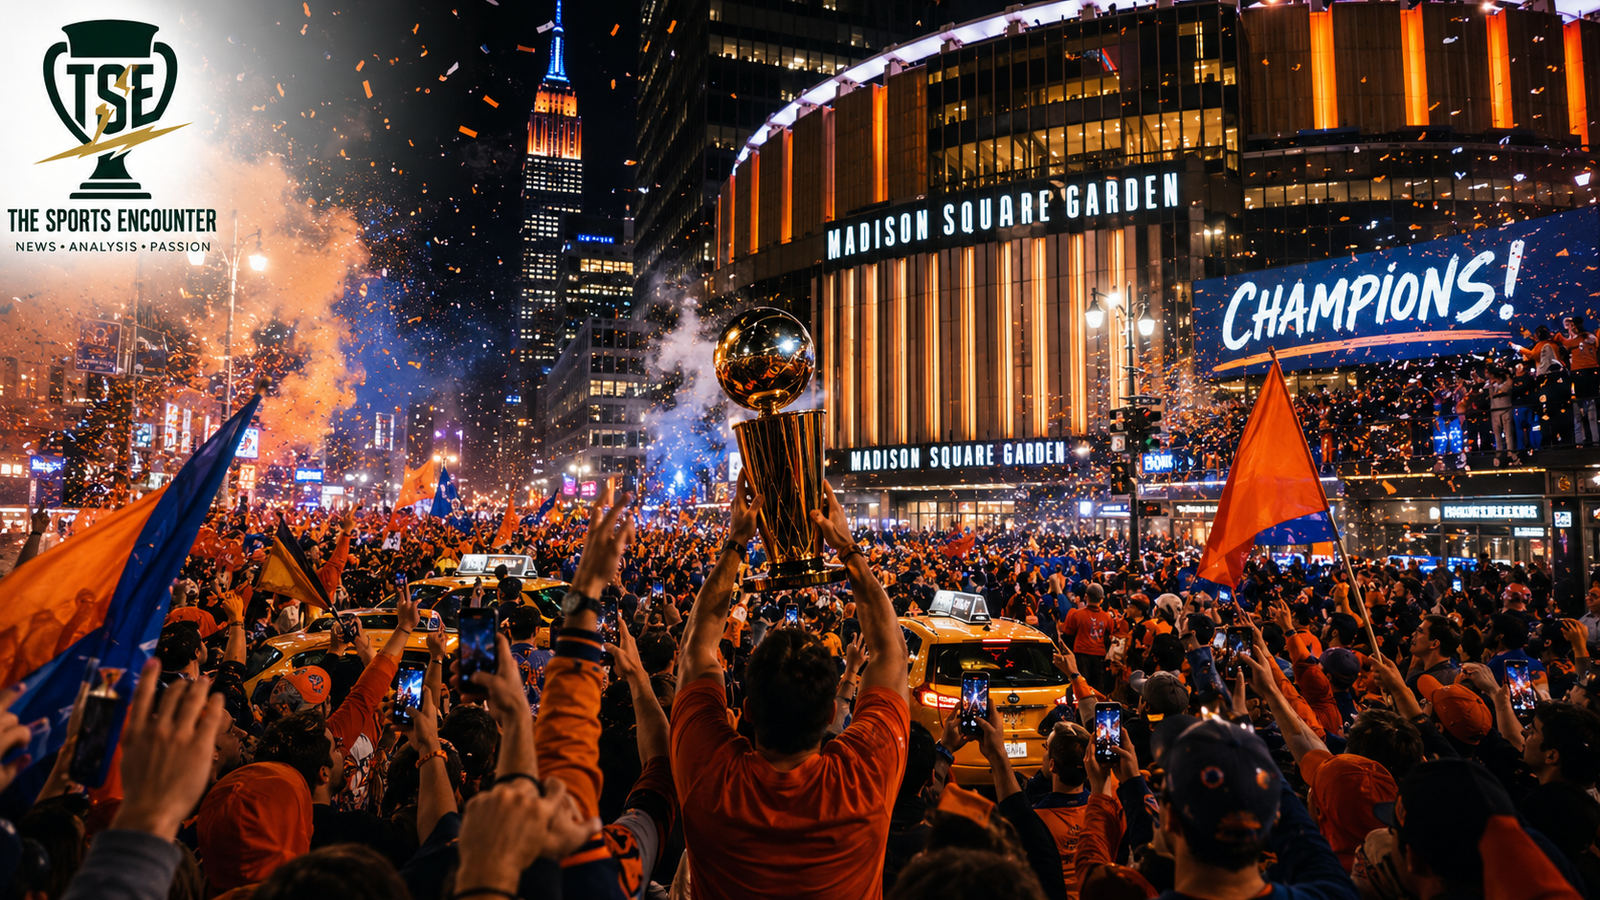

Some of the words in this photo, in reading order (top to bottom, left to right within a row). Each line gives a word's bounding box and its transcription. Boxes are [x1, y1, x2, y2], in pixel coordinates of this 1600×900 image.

[827, 209, 929, 260] MADISON
[943, 189, 1050, 235] SQUARE
[1066, 172, 1179, 218] GARDEN
[850, 447, 921, 472] MADISON
[930, 443, 994, 469] SQUARE
[1003, 441, 1065, 466] GARDEN
